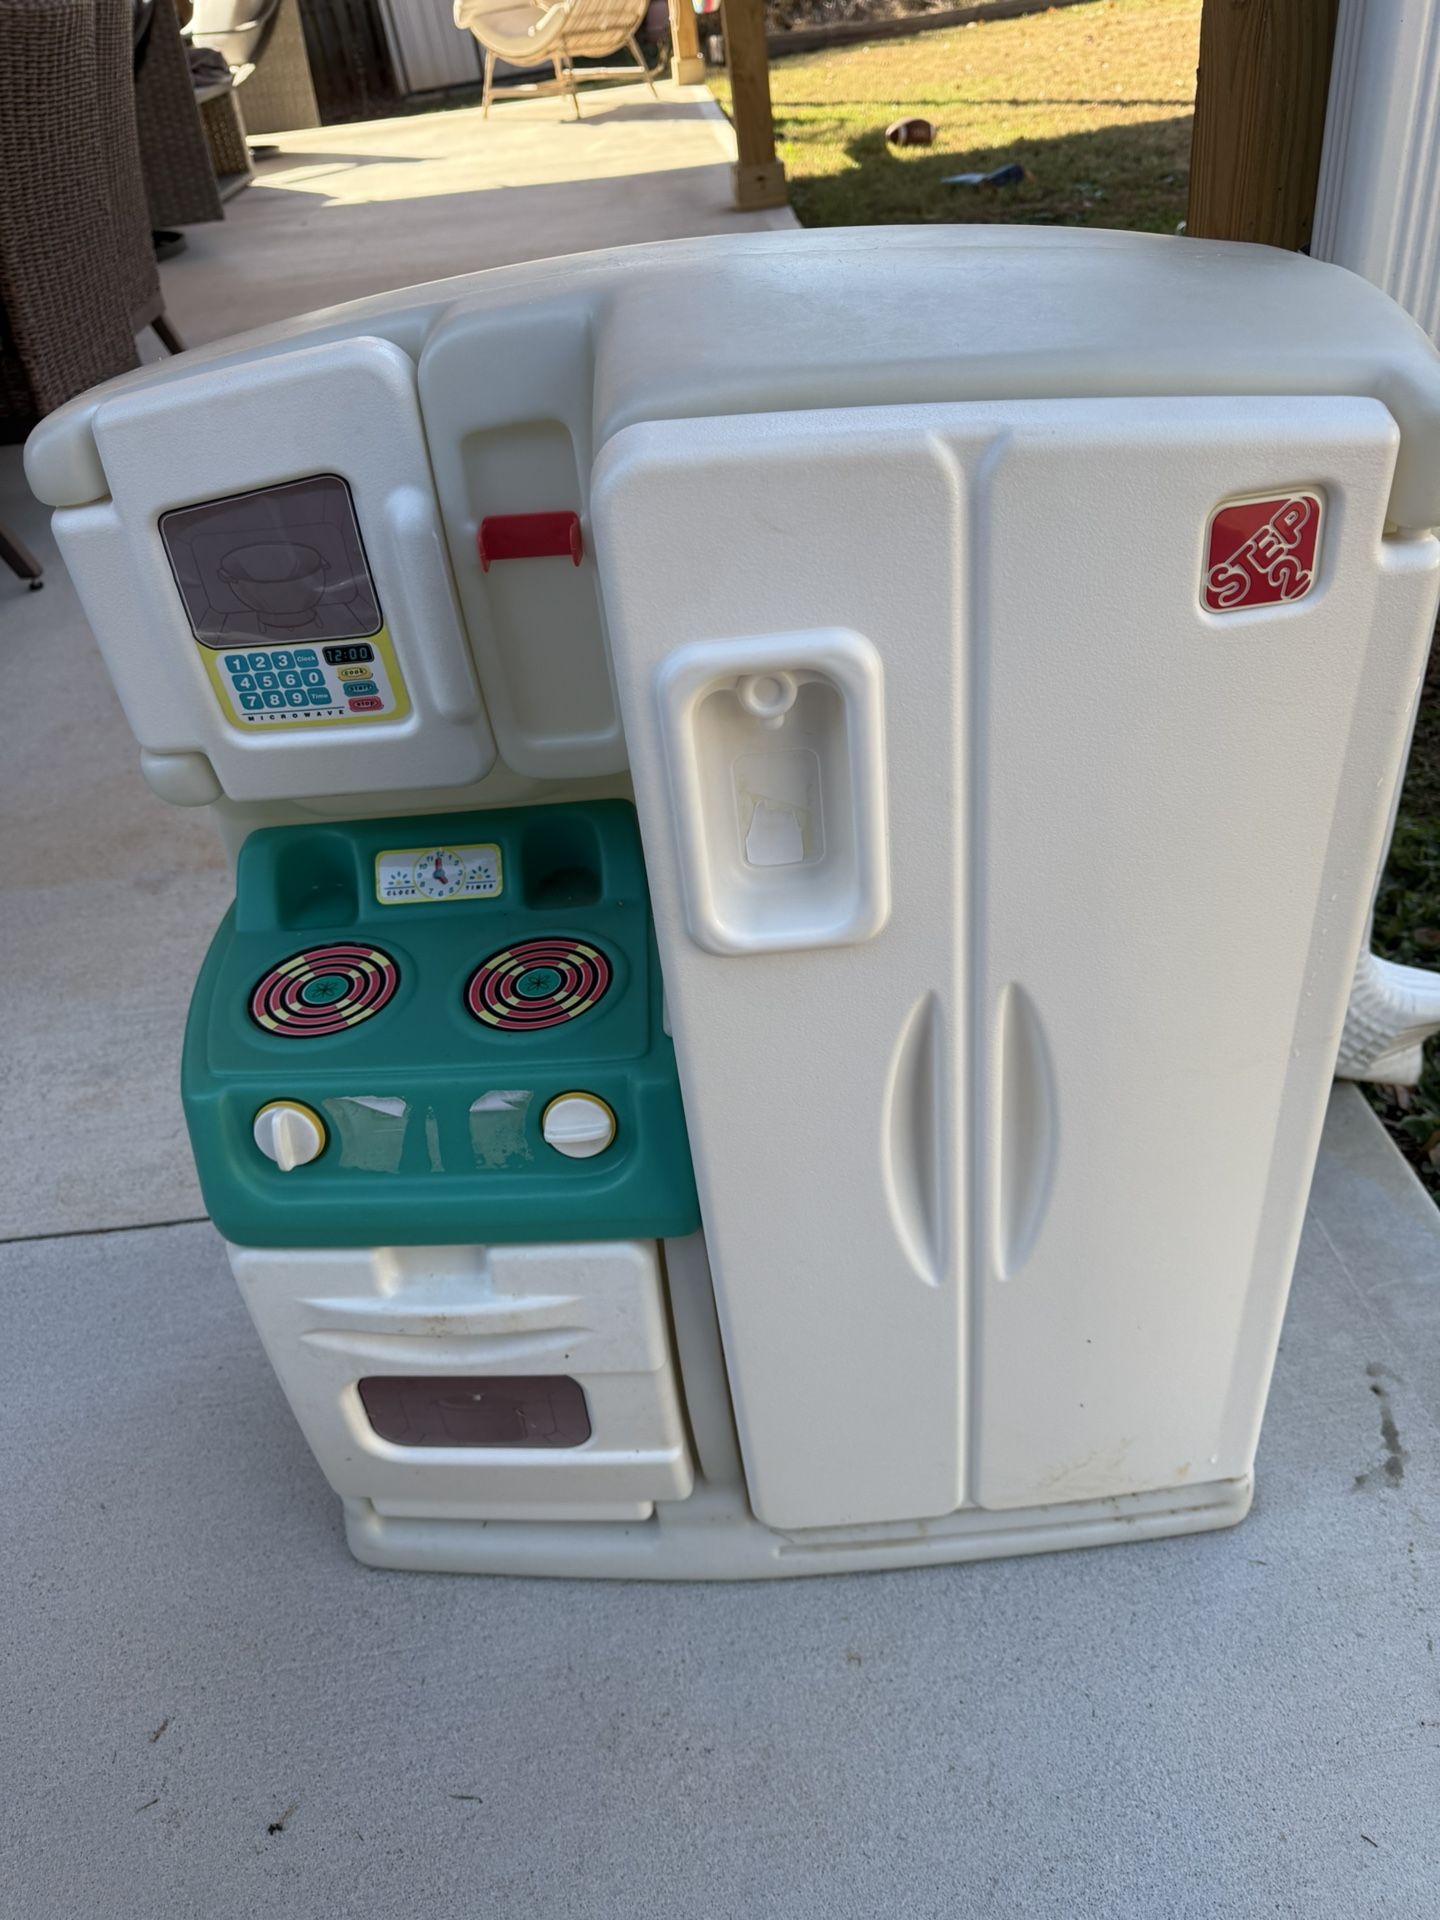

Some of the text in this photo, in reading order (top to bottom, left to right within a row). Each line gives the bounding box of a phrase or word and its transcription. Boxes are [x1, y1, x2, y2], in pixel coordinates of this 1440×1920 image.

[1208, 497, 1311, 607] STEP
[1268, 556, 1312, 600] 2
[327, 647, 369, 662] 12:00
[232, 655, 316, 670] 1 2 3 Clock
[240, 672, 319, 689] 4 5 6 0
[246, 696, 257, 707] 7
[269, 694, 280, 705] 8
[292, 692, 302, 704] 9
[247, 709, 345, 721] MICROWAVE
